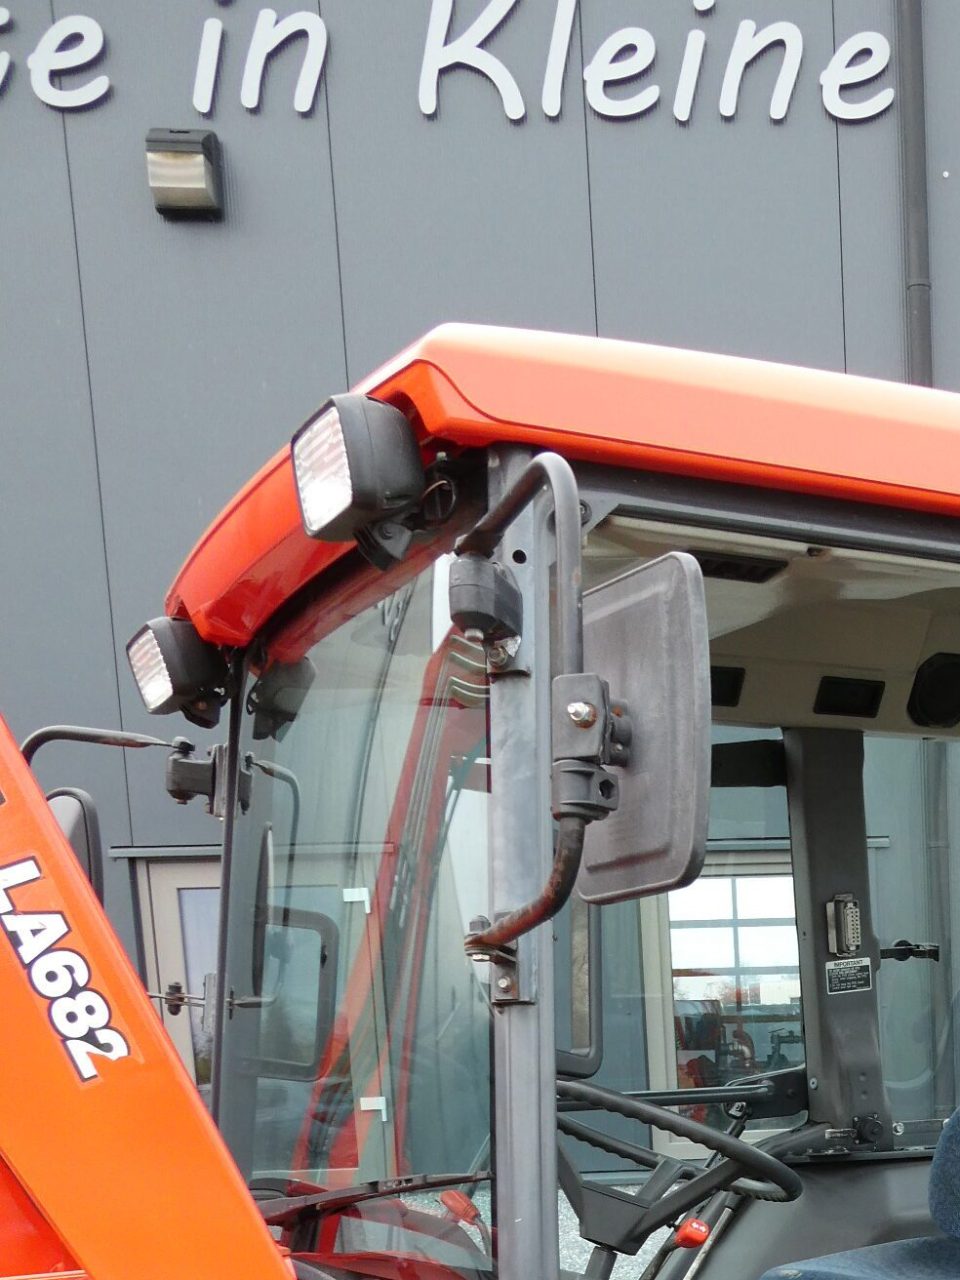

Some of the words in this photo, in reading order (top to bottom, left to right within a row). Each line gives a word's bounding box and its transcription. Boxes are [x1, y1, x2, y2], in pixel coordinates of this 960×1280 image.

[0, 6, 110, 109] e
[192, 0, 330, 115] in
[417, 0, 896, 121] Kleine
[0, 855, 130, 1082] LA682
[834, 960, 863, 968] IMPORTANT
